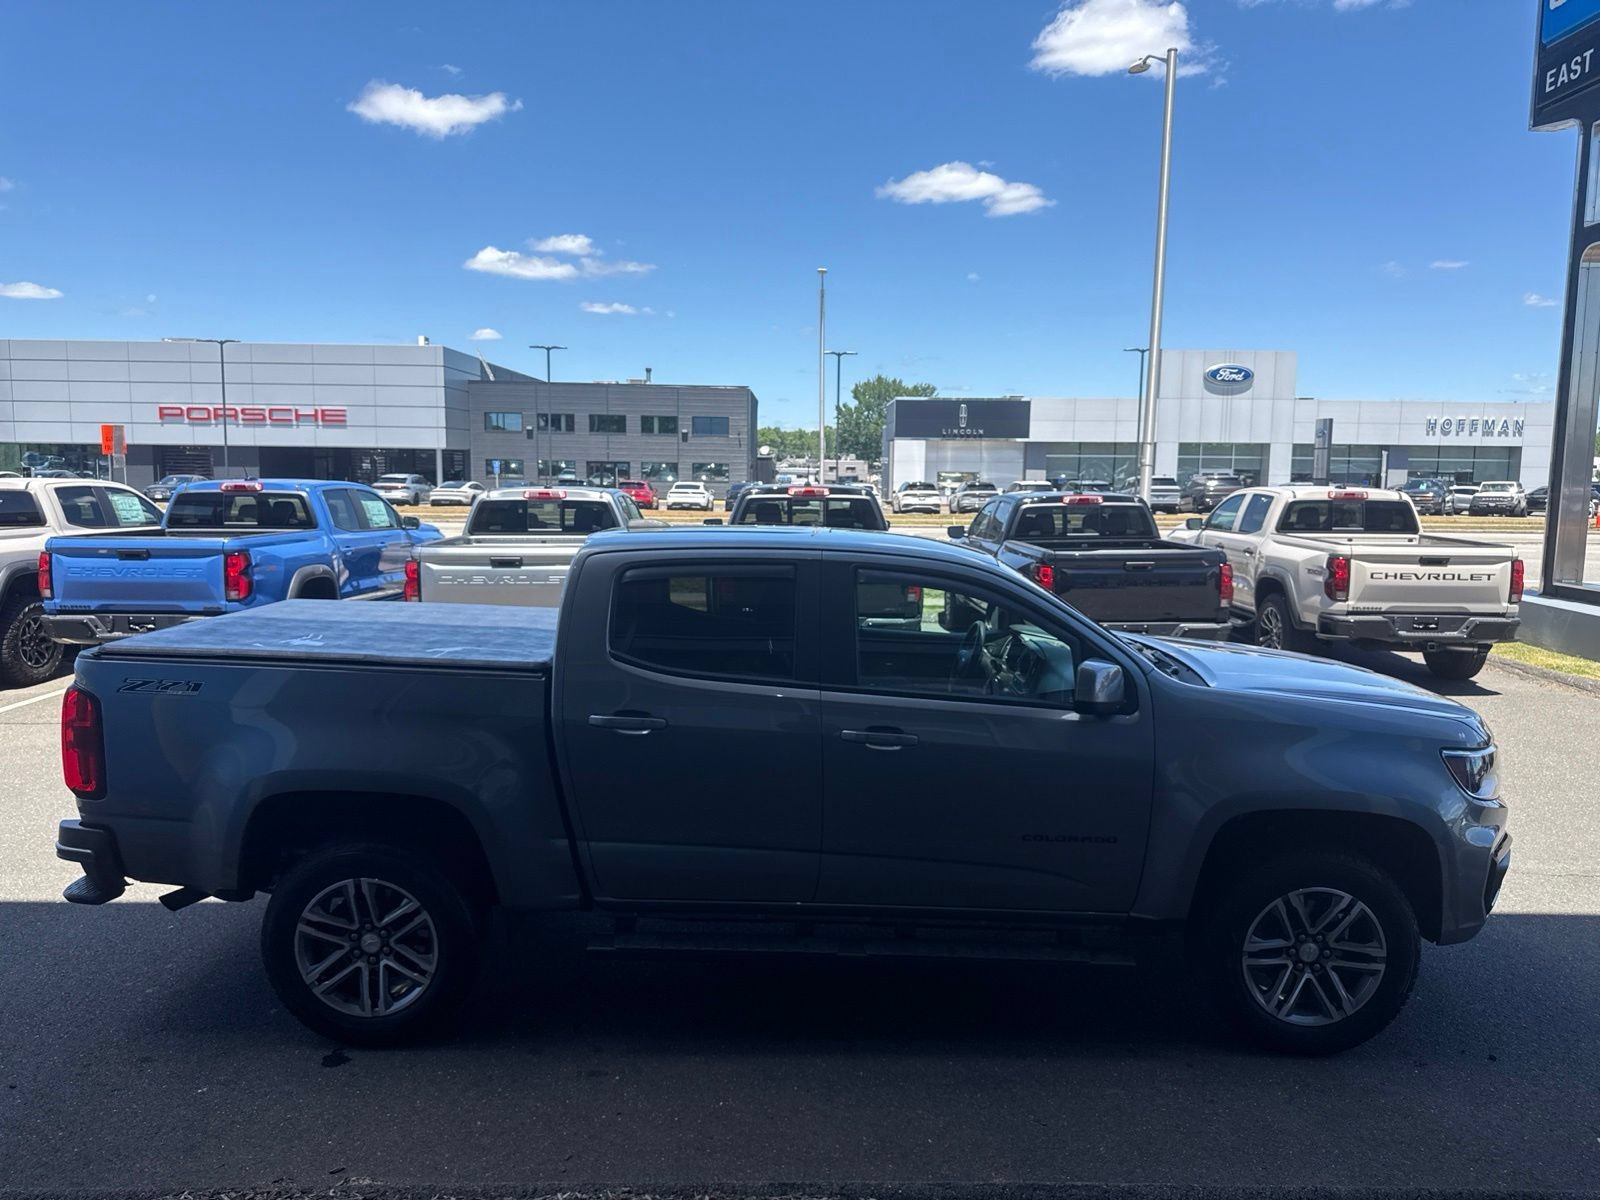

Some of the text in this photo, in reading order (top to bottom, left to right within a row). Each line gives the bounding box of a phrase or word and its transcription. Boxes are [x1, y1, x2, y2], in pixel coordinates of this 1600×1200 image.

[1545, 48, 1595, 93] EAST
[1216, 368, 1246, 381] Ford
[158, 406, 347, 423] PORSCHE
[1426, 416, 1524, 433] HOFFMAN
[66, 566, 204, 578] CHEVROLET
[1370, 571, 1497, 582] CHEVROLET
[438, 575, 567, 584] CHEVROLE
[116, 678, 205, 694] Z71
